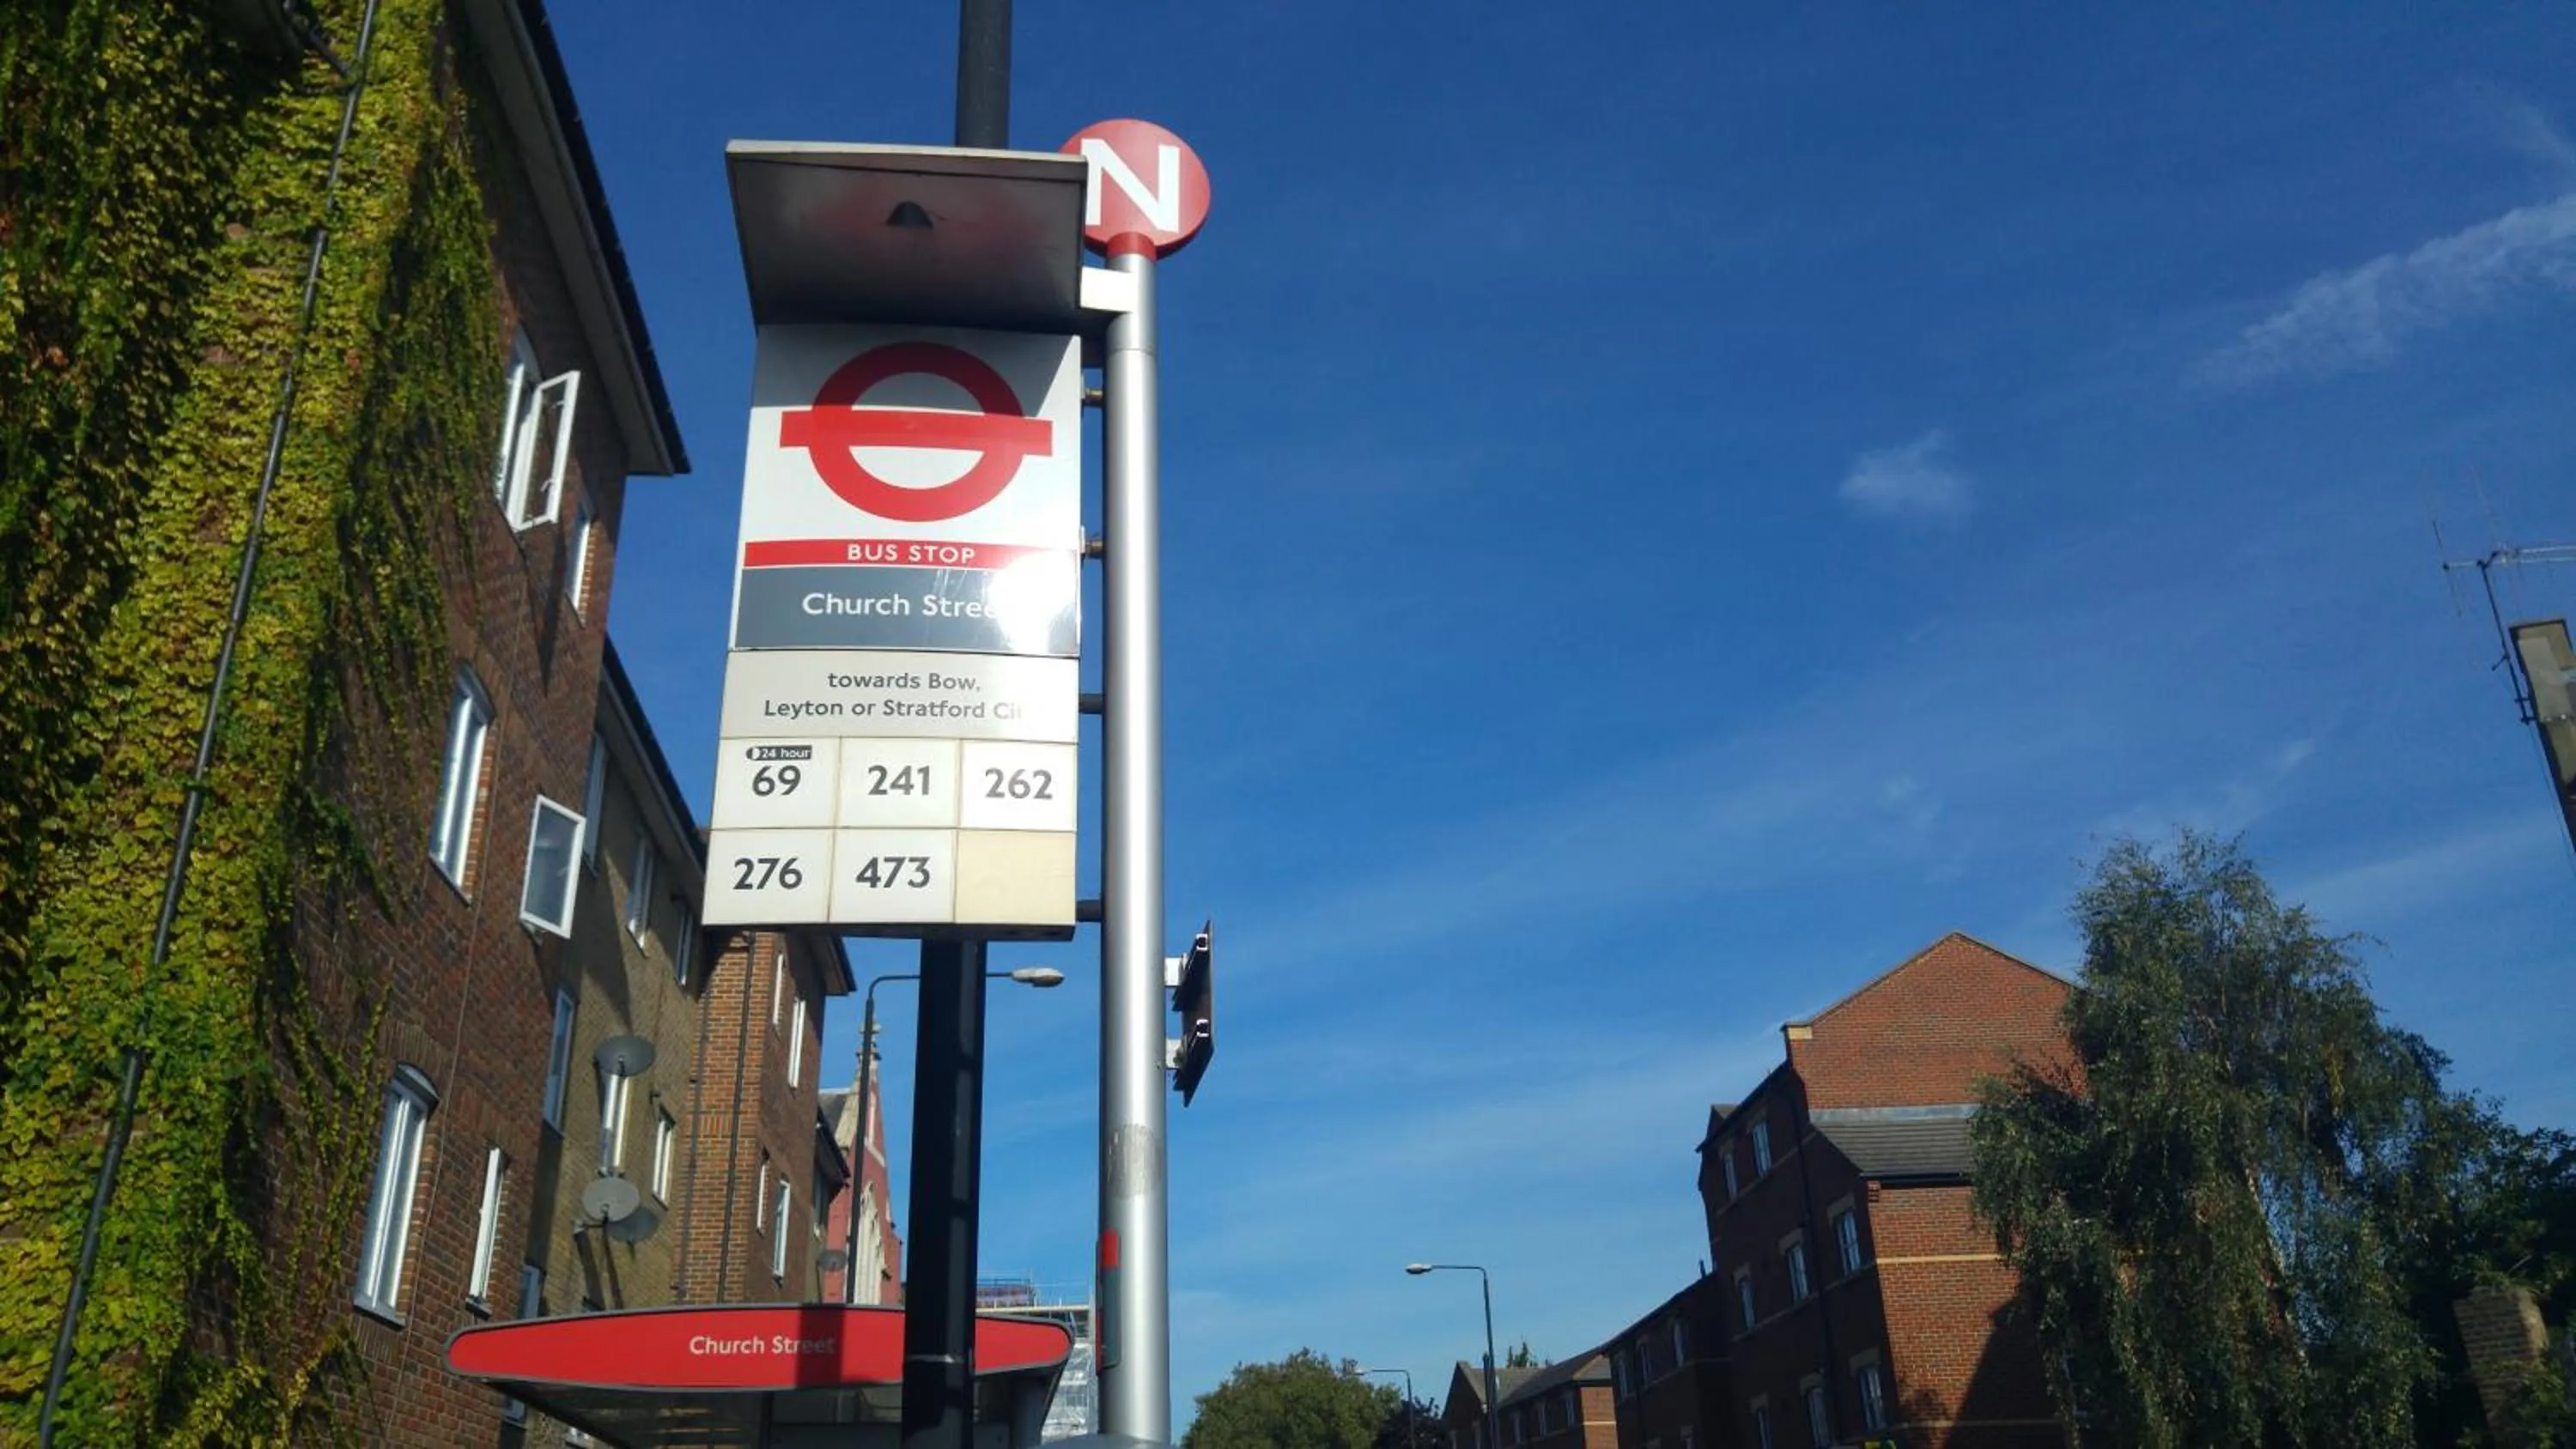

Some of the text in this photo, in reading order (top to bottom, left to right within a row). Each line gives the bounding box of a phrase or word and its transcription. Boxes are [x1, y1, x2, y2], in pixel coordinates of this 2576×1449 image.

[1081, 138, 1180, 233] N
[848, 543, 976, 563] BUS STOP
[801, 592, 1000, 619] Church Stree
[828, 672, 981, 692] towards Bow,
[764, 700, 843, 721] Leyton
[851, 702, 874, 717] or
[883, 700, 985, 719] Stratford
[762, 748, 811, 759] 24 hour
[752, 765, 801, 796] 69
[868, 765, 930, 796] 241
[985, 768, 1053, 799] 262
[733, 858, 803, 889] 276
[856, 856, 930, 888] 473
[690, 1336, 835, 1354] Church Street
